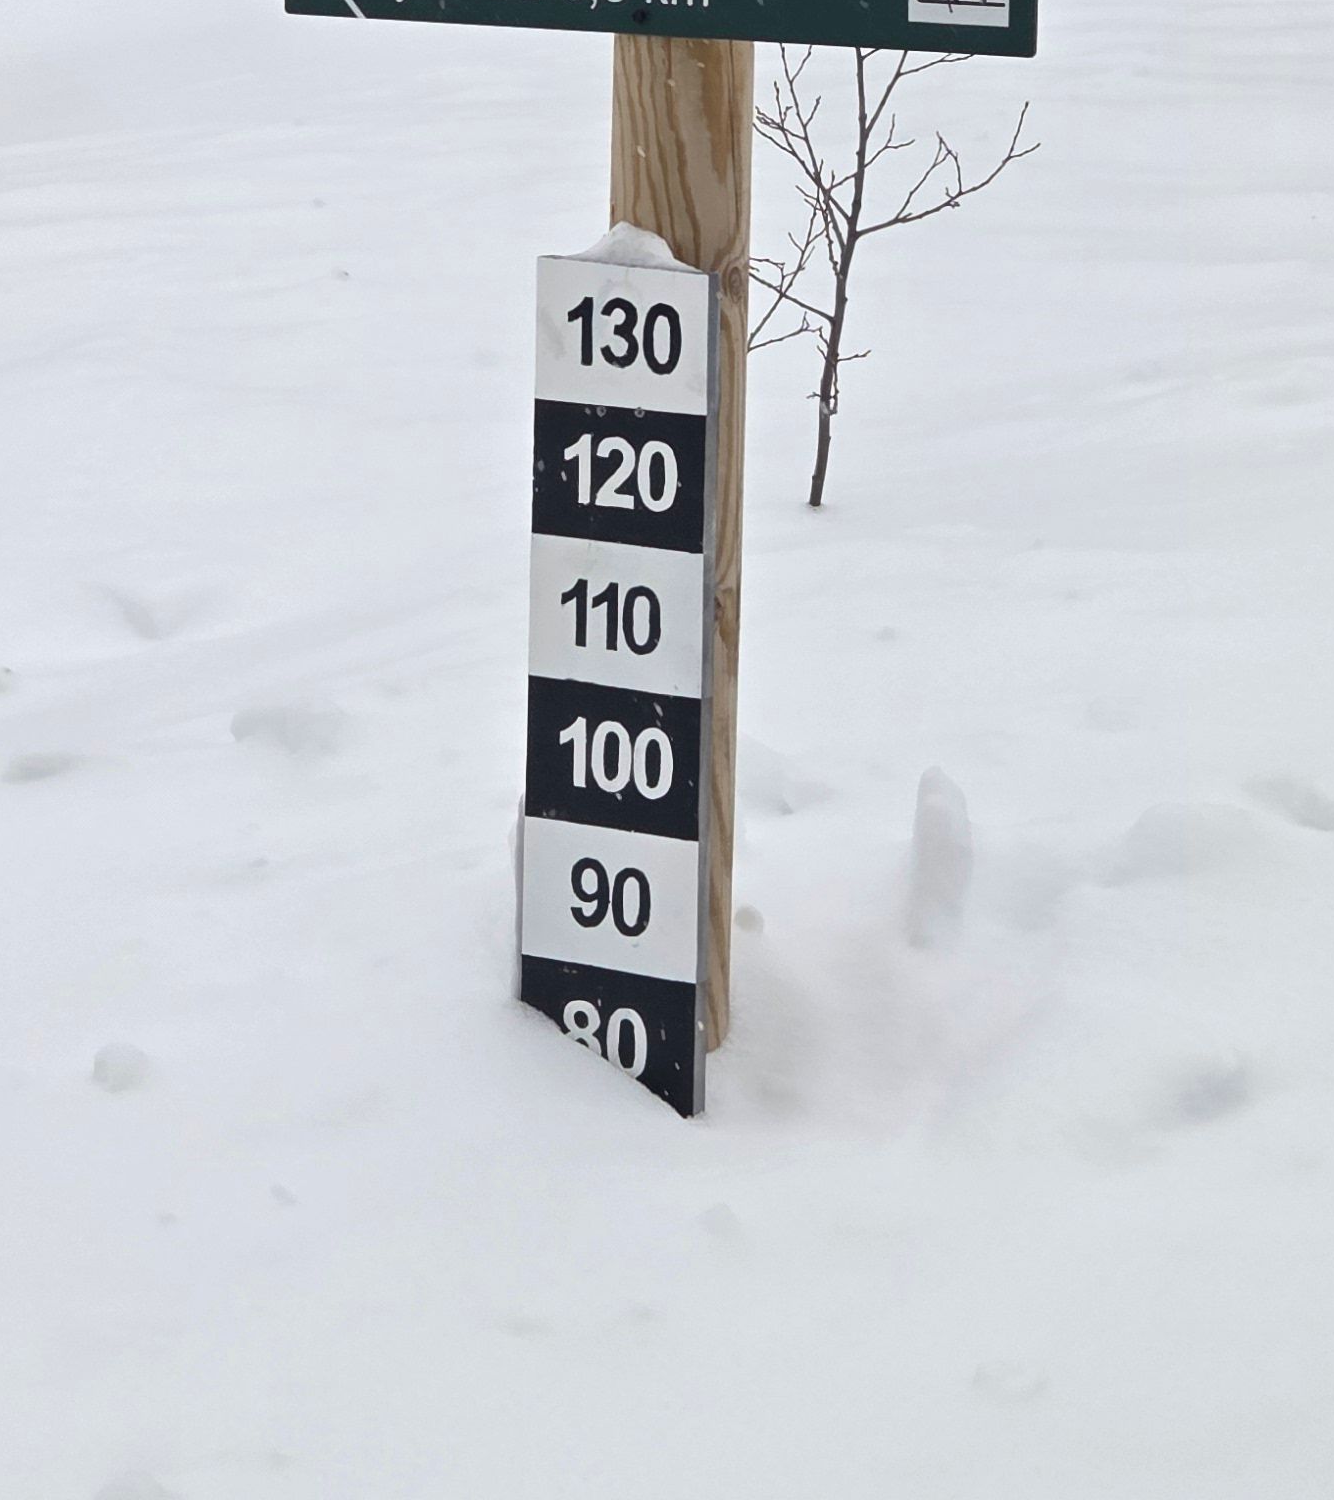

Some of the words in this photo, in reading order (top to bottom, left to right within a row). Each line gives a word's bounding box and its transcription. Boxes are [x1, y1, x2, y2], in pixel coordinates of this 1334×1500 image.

[567, 296, 683, 376] 130
[563, 435, 678, 513] 120
[560, 579, 662, 657] 110
[558, 717, 674, 800] 100
[570, 857, 651, 938] 90
[563, 1000, 648, 1079] 80
